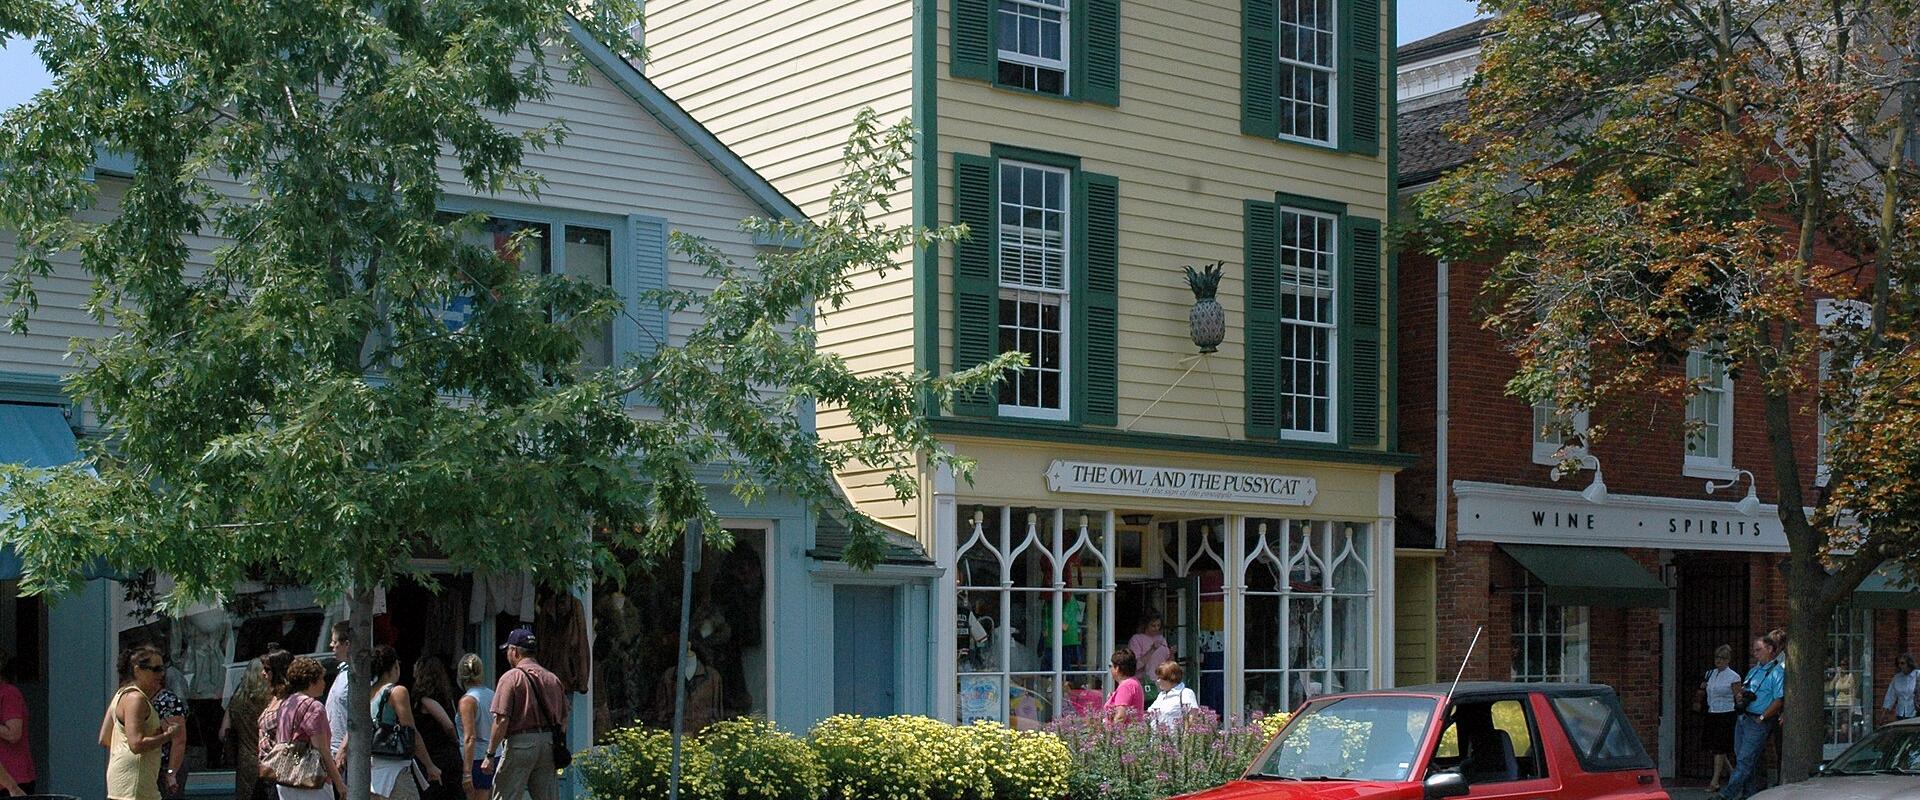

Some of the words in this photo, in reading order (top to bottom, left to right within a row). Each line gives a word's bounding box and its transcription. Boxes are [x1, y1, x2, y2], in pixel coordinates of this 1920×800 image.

[1072, 465, 1107, 483] THE
[1110, 467, 1147, 486] OWL
[1149, 471, 1186, 489] AND
[1189, 472, 1221, 491] THE
[1223, 475, 1301, 495] PUSSYCAT
[1532, 511, 1594, 530] WINE
[1669, 518, 1761, 536] SPIRITS
